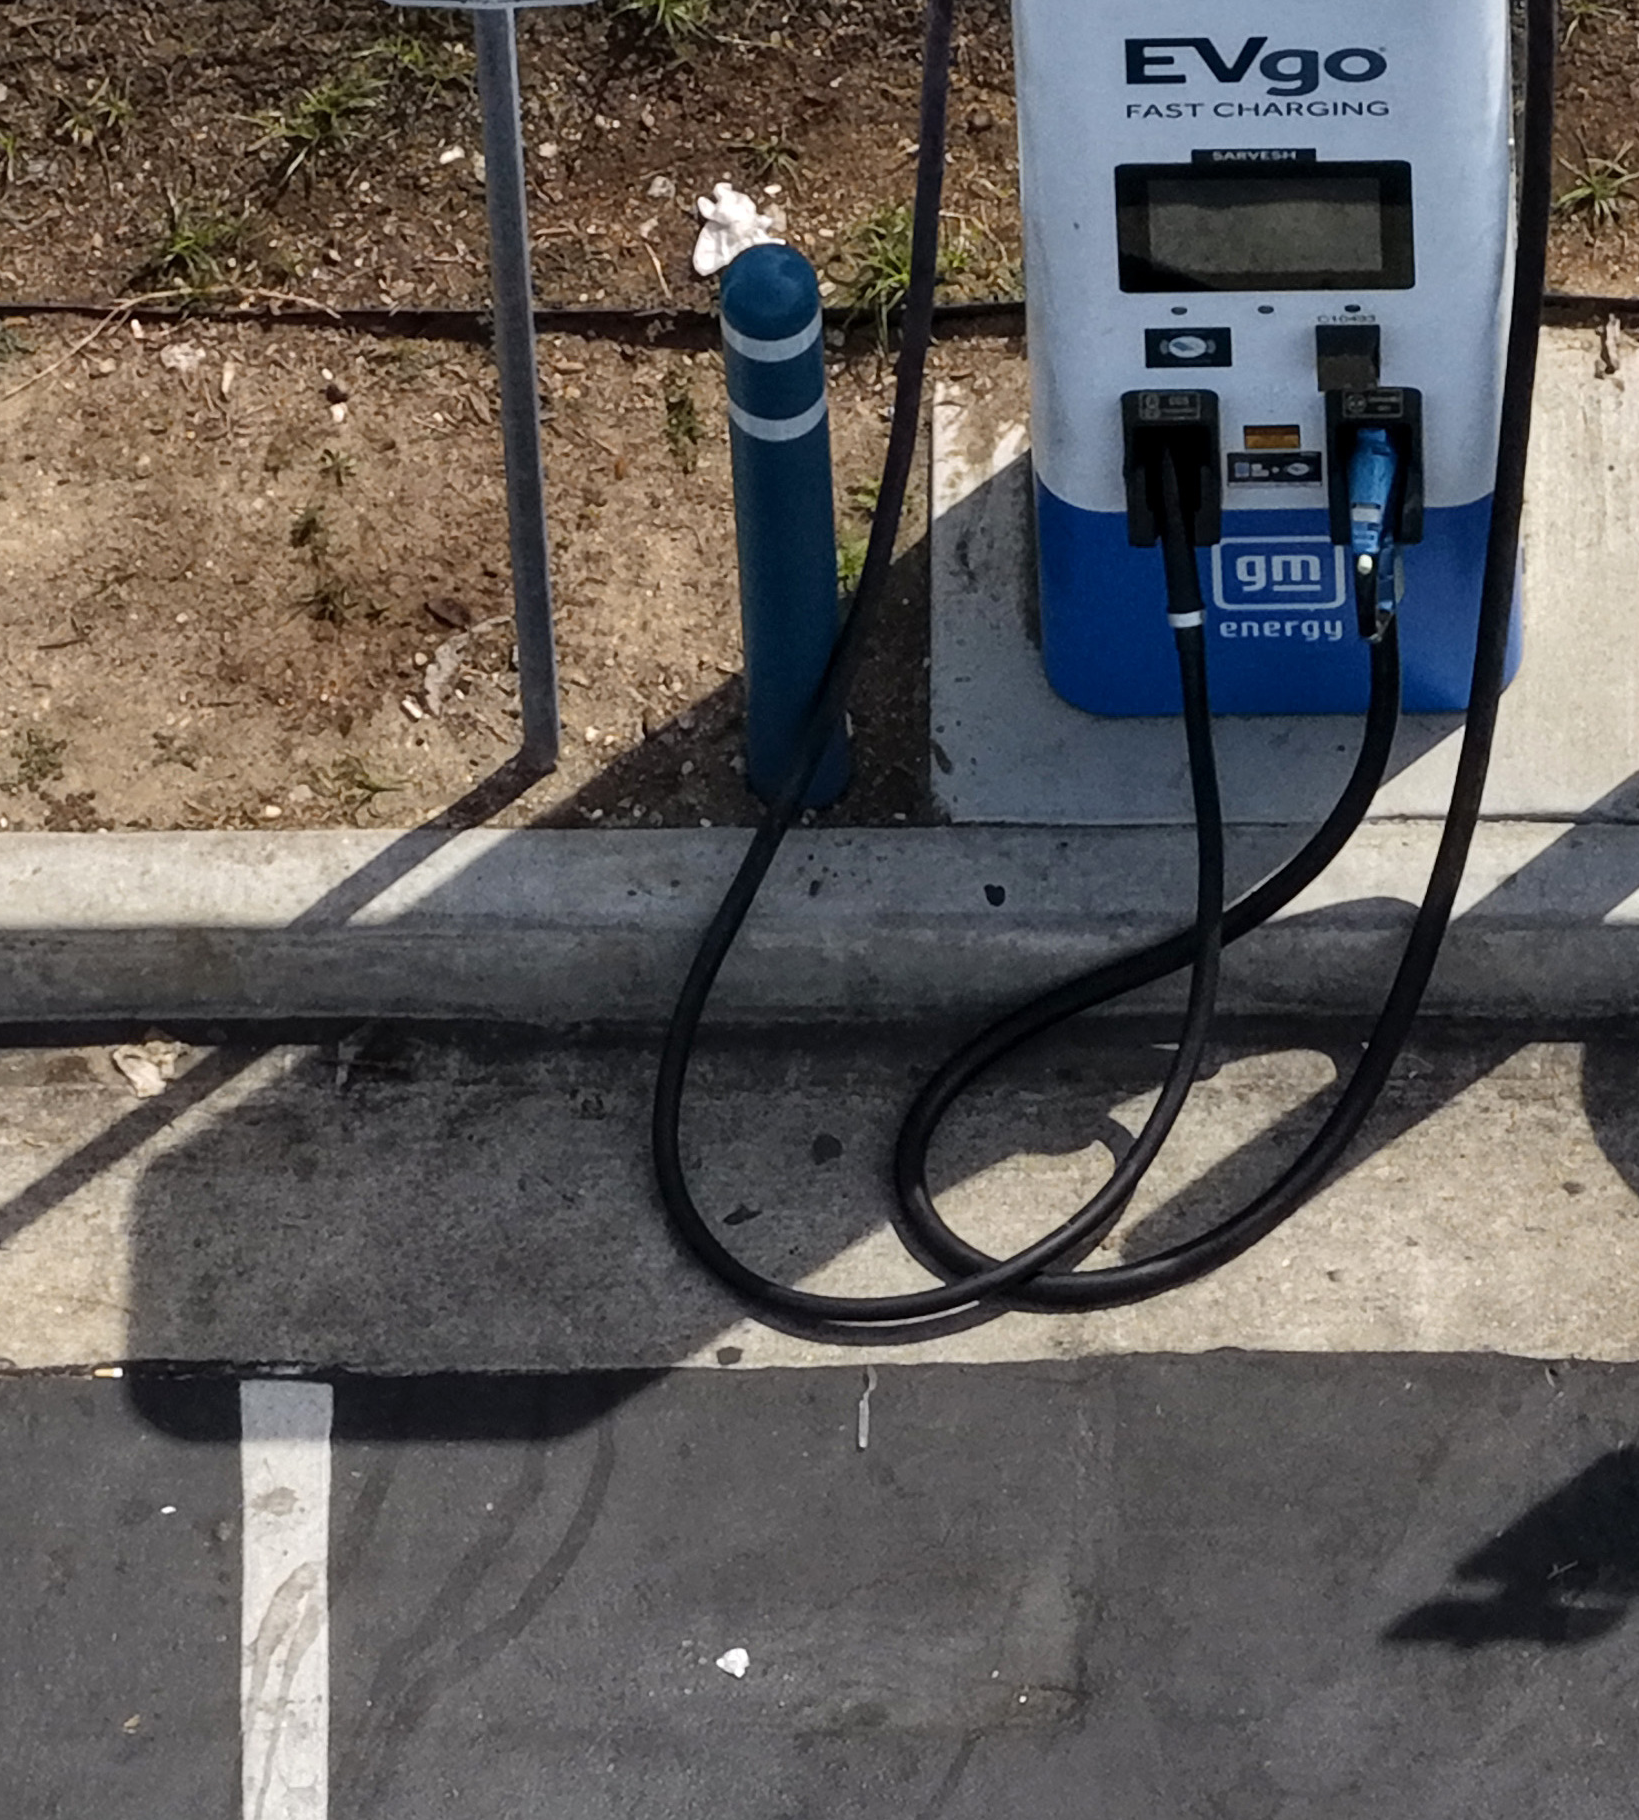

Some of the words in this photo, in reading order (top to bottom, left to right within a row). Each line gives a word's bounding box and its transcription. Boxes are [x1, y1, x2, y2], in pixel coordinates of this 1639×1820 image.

[1125, 37, 1388, 97] EVgo
[1126, 103, 1204, 119] FAST
[1213, 101, 1390, 118] CHARGING
[1212, 151, 1297, 160] SARVESH
[1235, 554, 1322, 592] gm
[1219, 619, 1343, 643] energy
